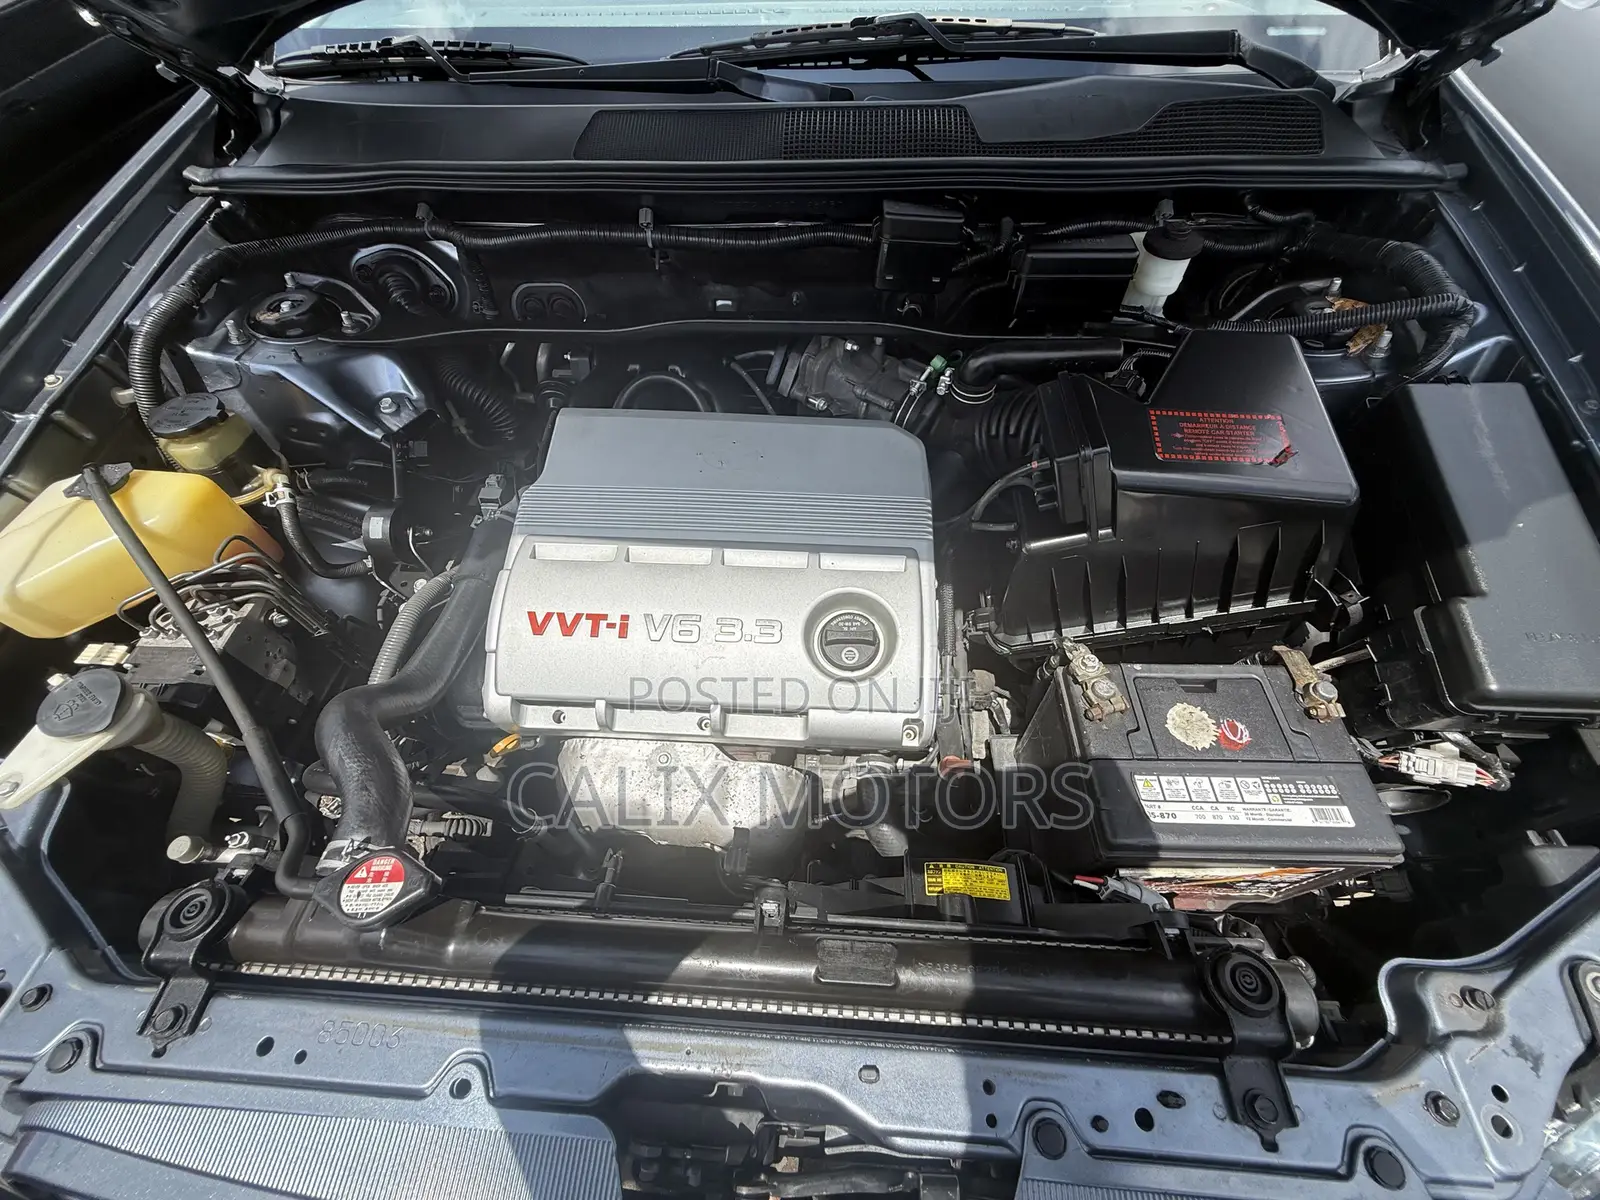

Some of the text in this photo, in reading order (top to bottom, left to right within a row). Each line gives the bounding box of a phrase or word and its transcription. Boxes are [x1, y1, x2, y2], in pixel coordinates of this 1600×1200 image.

[527, 610, 783, 644] VVT-i V6 3.3
[317, 1019, 404, 1049] 85003
